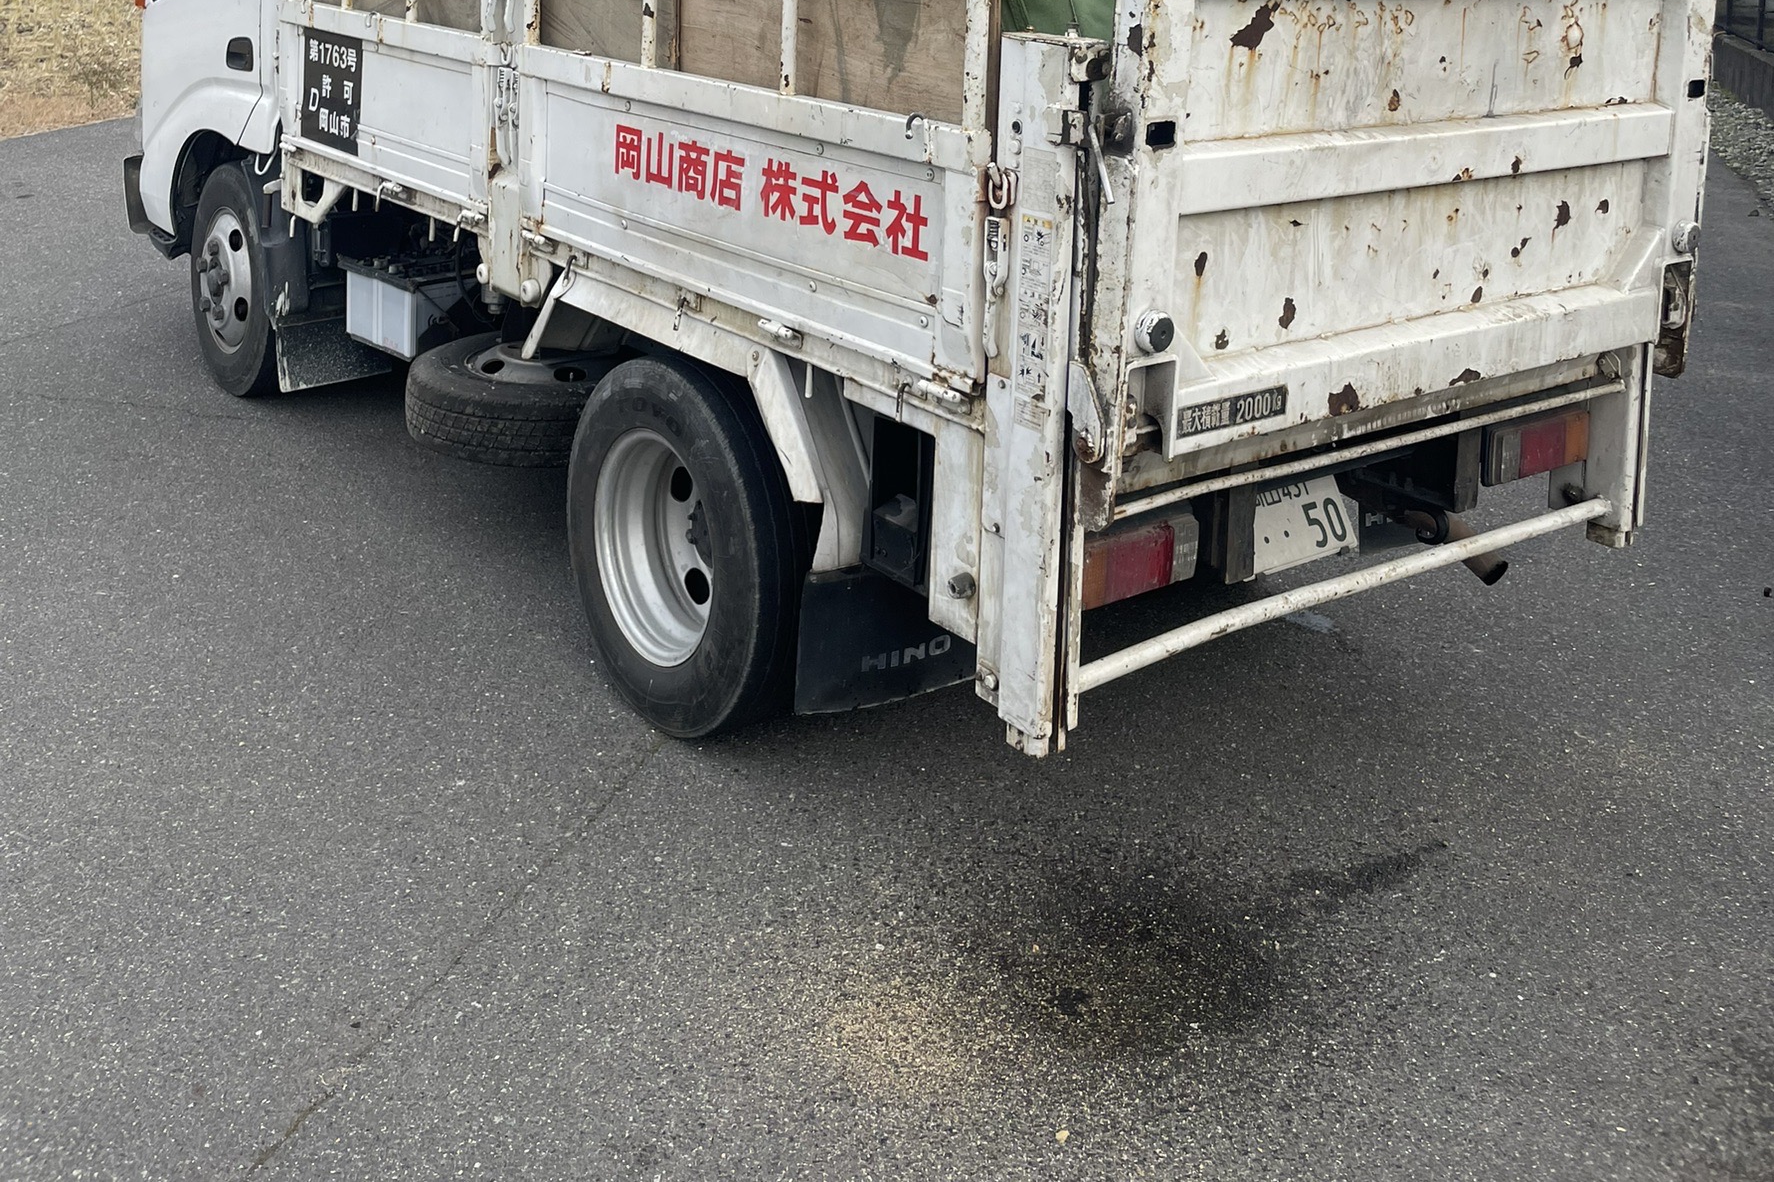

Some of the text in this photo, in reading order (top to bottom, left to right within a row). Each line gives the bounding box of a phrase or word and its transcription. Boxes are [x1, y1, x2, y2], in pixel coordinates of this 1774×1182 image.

[309, 38, 357, 72] 第1763号
[308, 87, 320, 112] D
[318, 107, 350, 139] 岡山市
[614, 123, 746, 212] 岡山商店
[759, 157, 929, 262] 株式会社
[861, 634, 951, 672] HINO
